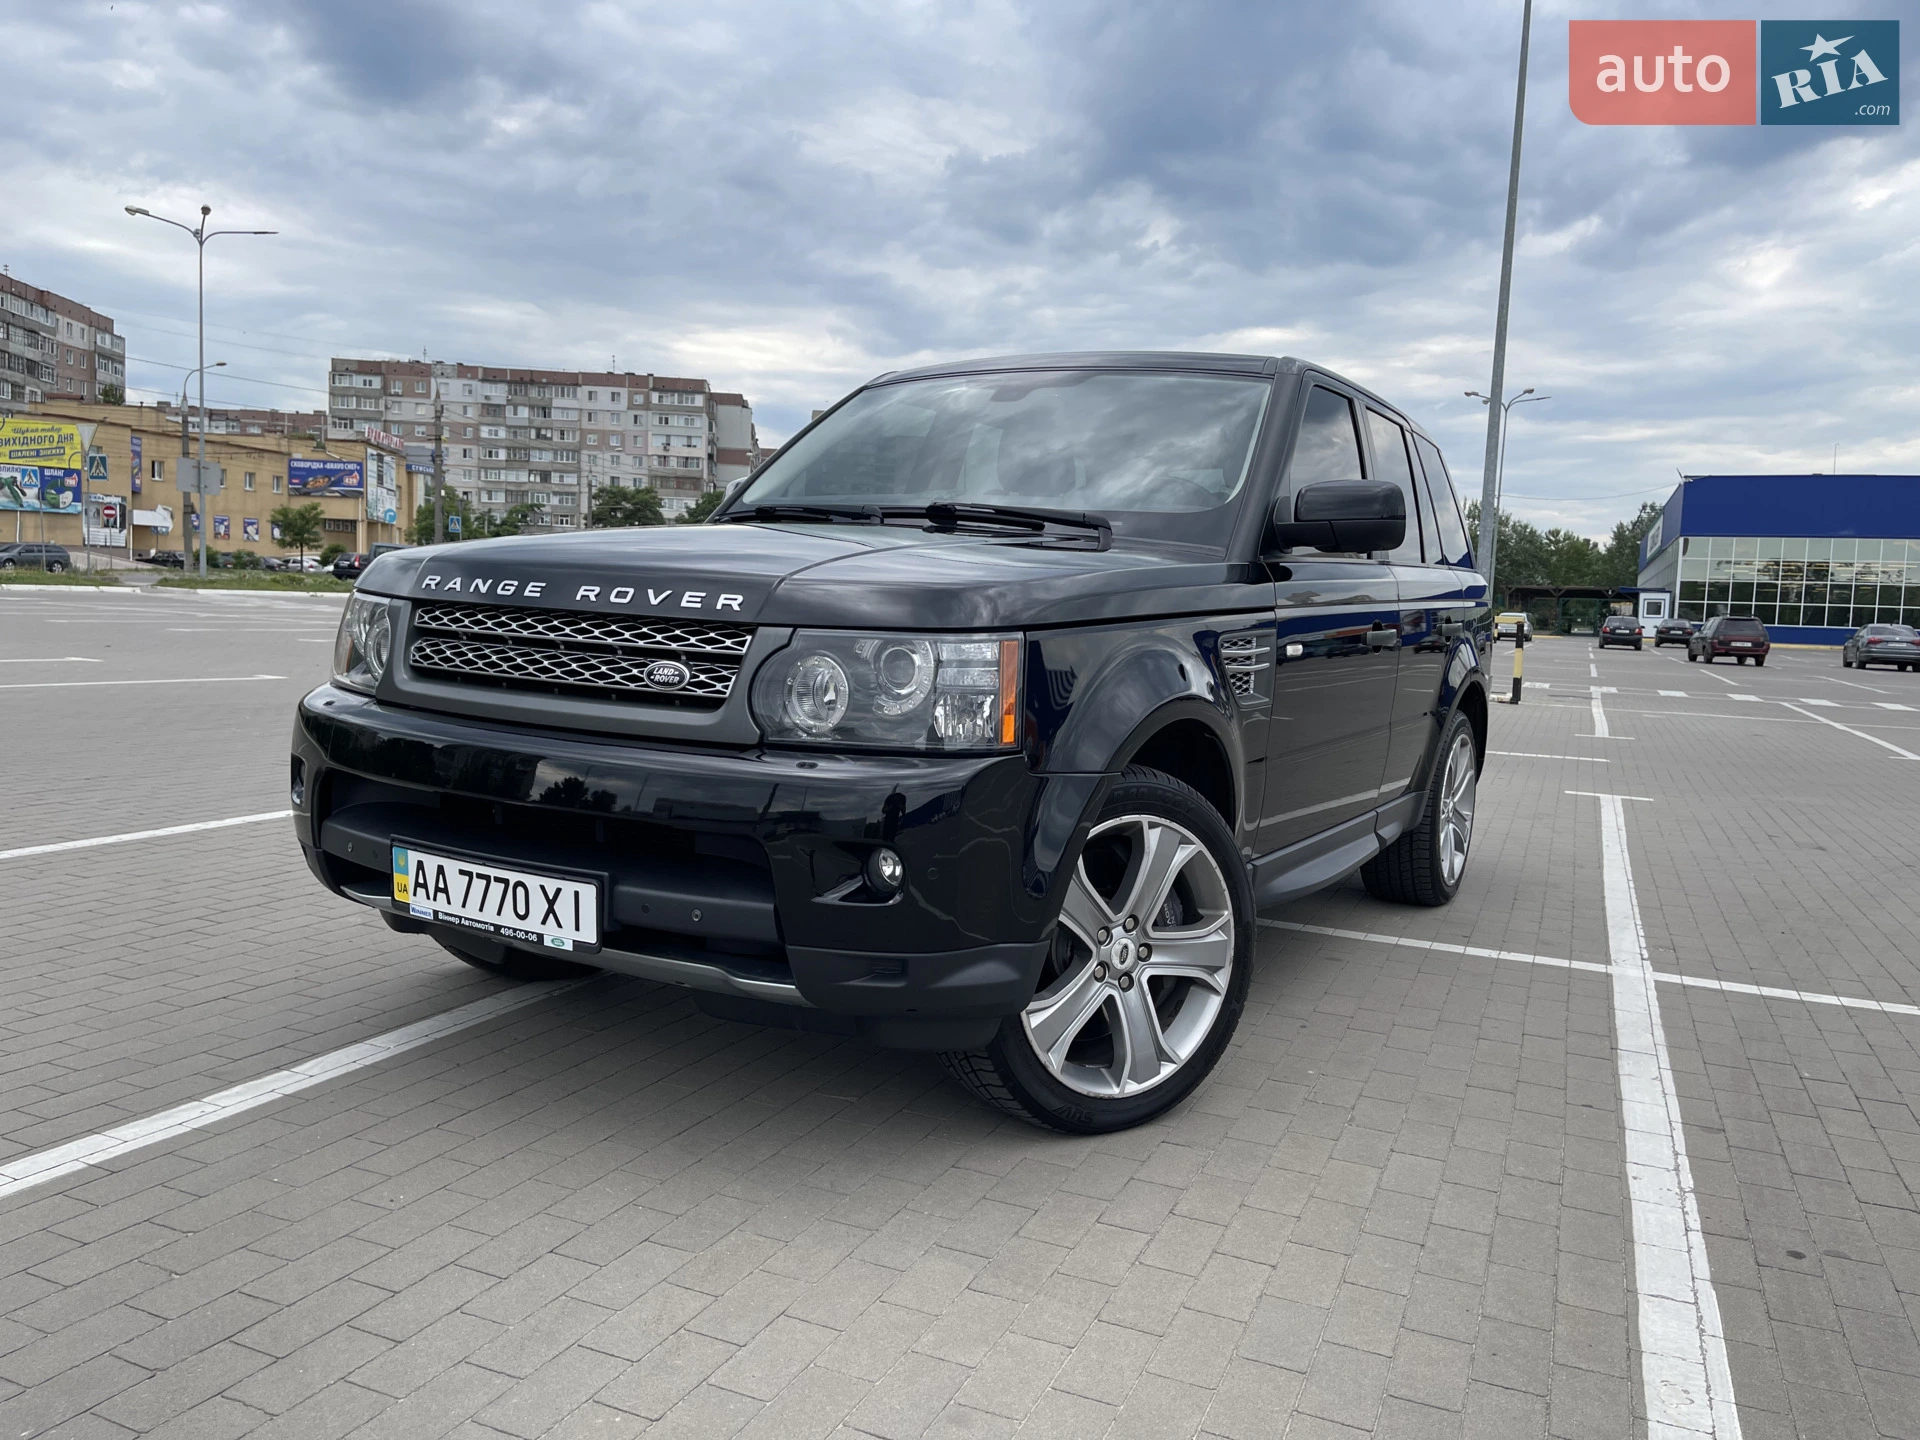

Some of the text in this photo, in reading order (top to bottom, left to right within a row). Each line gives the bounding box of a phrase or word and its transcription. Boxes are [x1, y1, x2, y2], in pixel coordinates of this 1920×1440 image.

[57, 433, 74, 445] ДНЯ
[11, 449, 37, 458] ШАЛЕНІ
[44, 468, 65, 477] ШЛАНГ
[421, 574, 745, 612] RANGE ROVER
[653, 667, 675, 676] LAND
[653, 675, 680, 684] ROVER
[396, 882, 409, 894] UA
[412, 859, 580, 932] AA 7770 XI
[500, 927, 538, 942] 496-00-06
